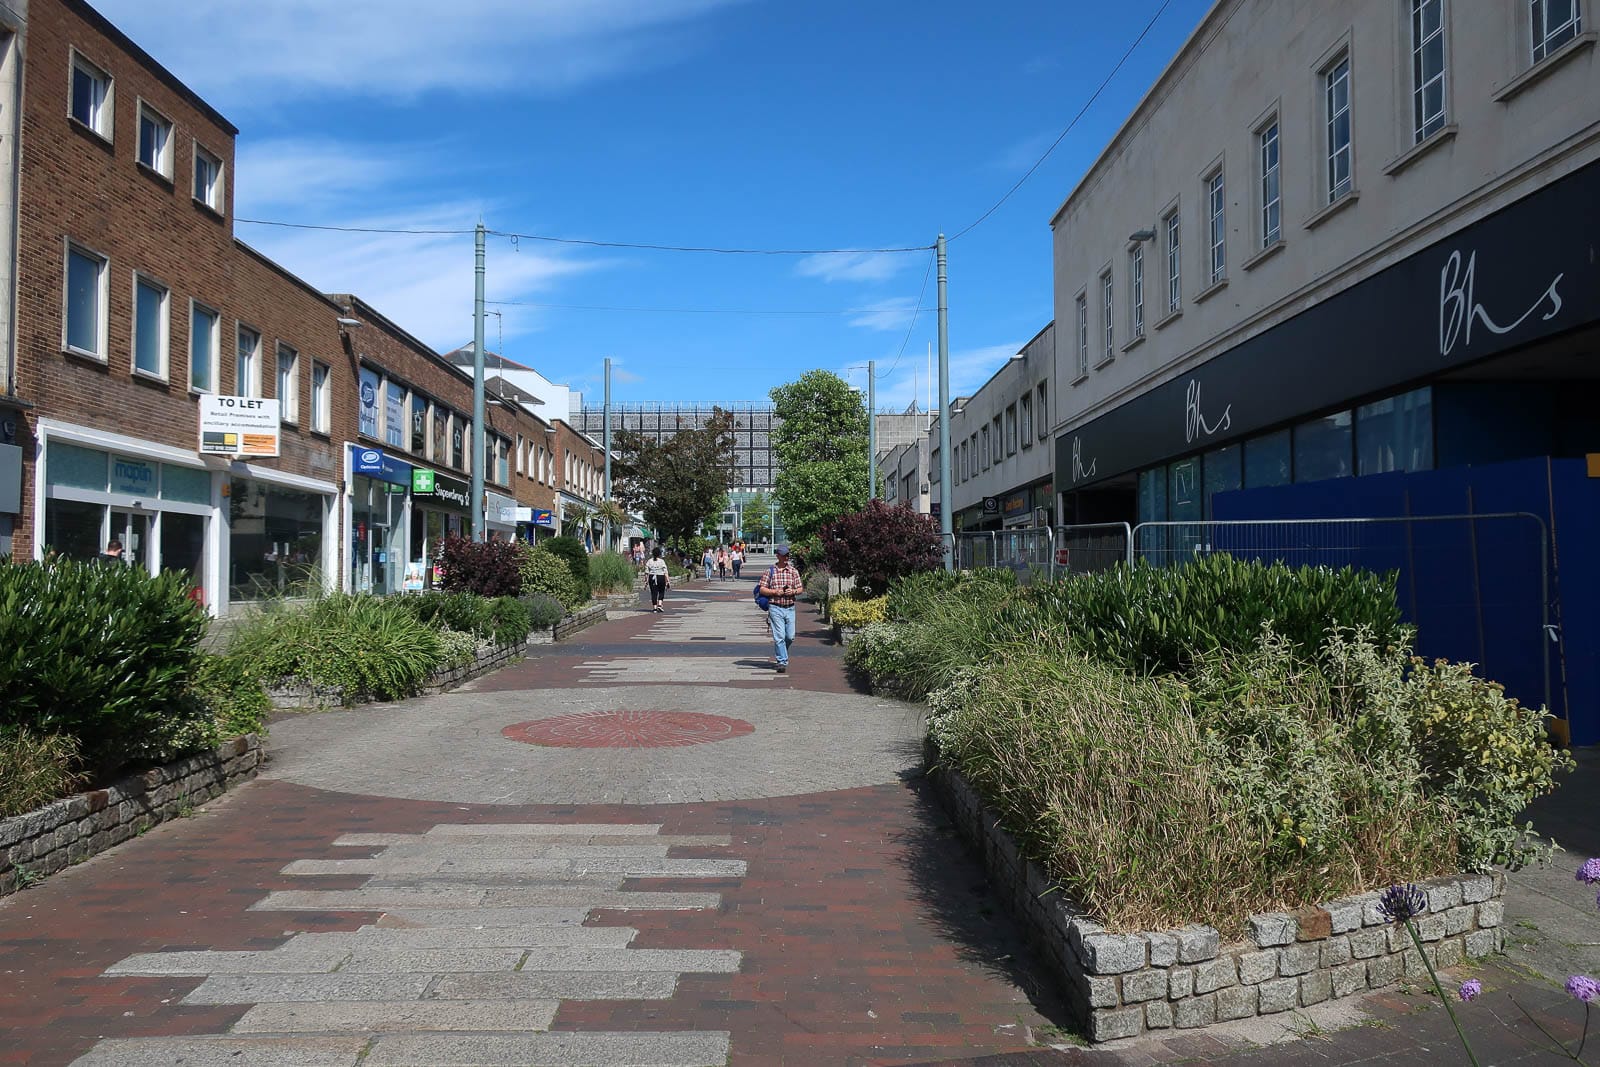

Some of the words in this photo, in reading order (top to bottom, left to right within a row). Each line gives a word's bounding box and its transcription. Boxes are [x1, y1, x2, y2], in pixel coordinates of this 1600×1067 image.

[1440, 249, 1564, 356] Bhs
[218, 398, 235, 407] TO
[240, 400, 264, 409] LET
[1186, 378, 1231, 443] Bhs
[115, 462, 152, 484] maplin
[1072, 436, 1097, 483] Bhs
[435, 482, 464, 506] Superdrug
